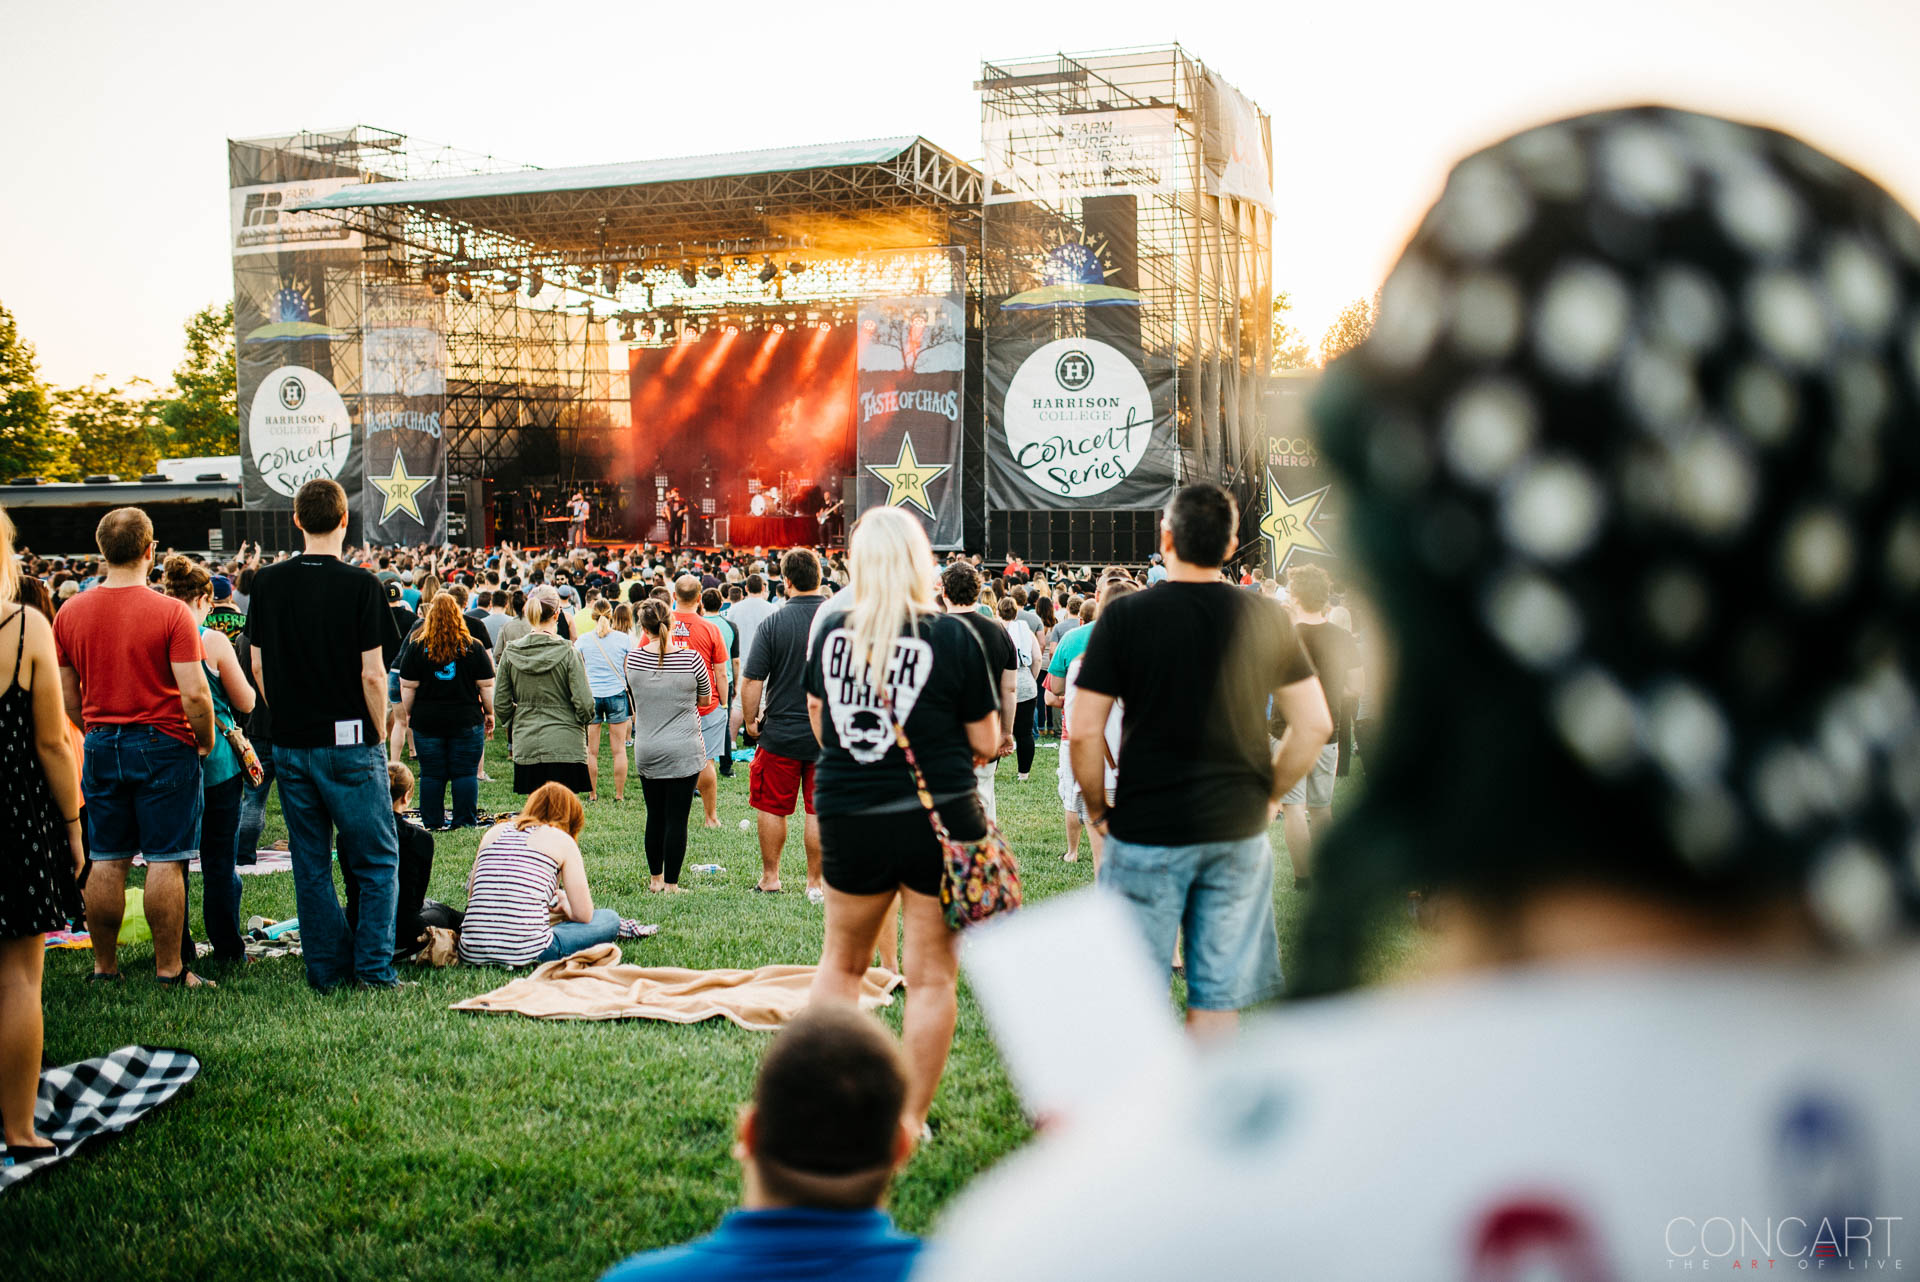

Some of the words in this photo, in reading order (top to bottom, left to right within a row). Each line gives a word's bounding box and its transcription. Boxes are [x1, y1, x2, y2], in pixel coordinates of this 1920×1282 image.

[1071, 121, 1112, 135] FARM
[285, 187, 315, 200] FARM
[861, 388, 899, 422] TASTE
[899, 391, 916, 410] OF
[915, 390, 959, 421] CHAOS
[1032, 397, 1120, 409] HARRISON
[265, 415, 325, 425] HARRISON
[1040, 410, 1112, 421] COLLEGE
[269, 425, 320, 435] COLLEGE
[364, 409, 392, 439] TASTE
[392, 411, 405, 428] OF
[405, 410, 442, 438] CHAOS
[1269, 453, 1319, 468] ENERGY
[202, 613, 247, 628] ANTERA
